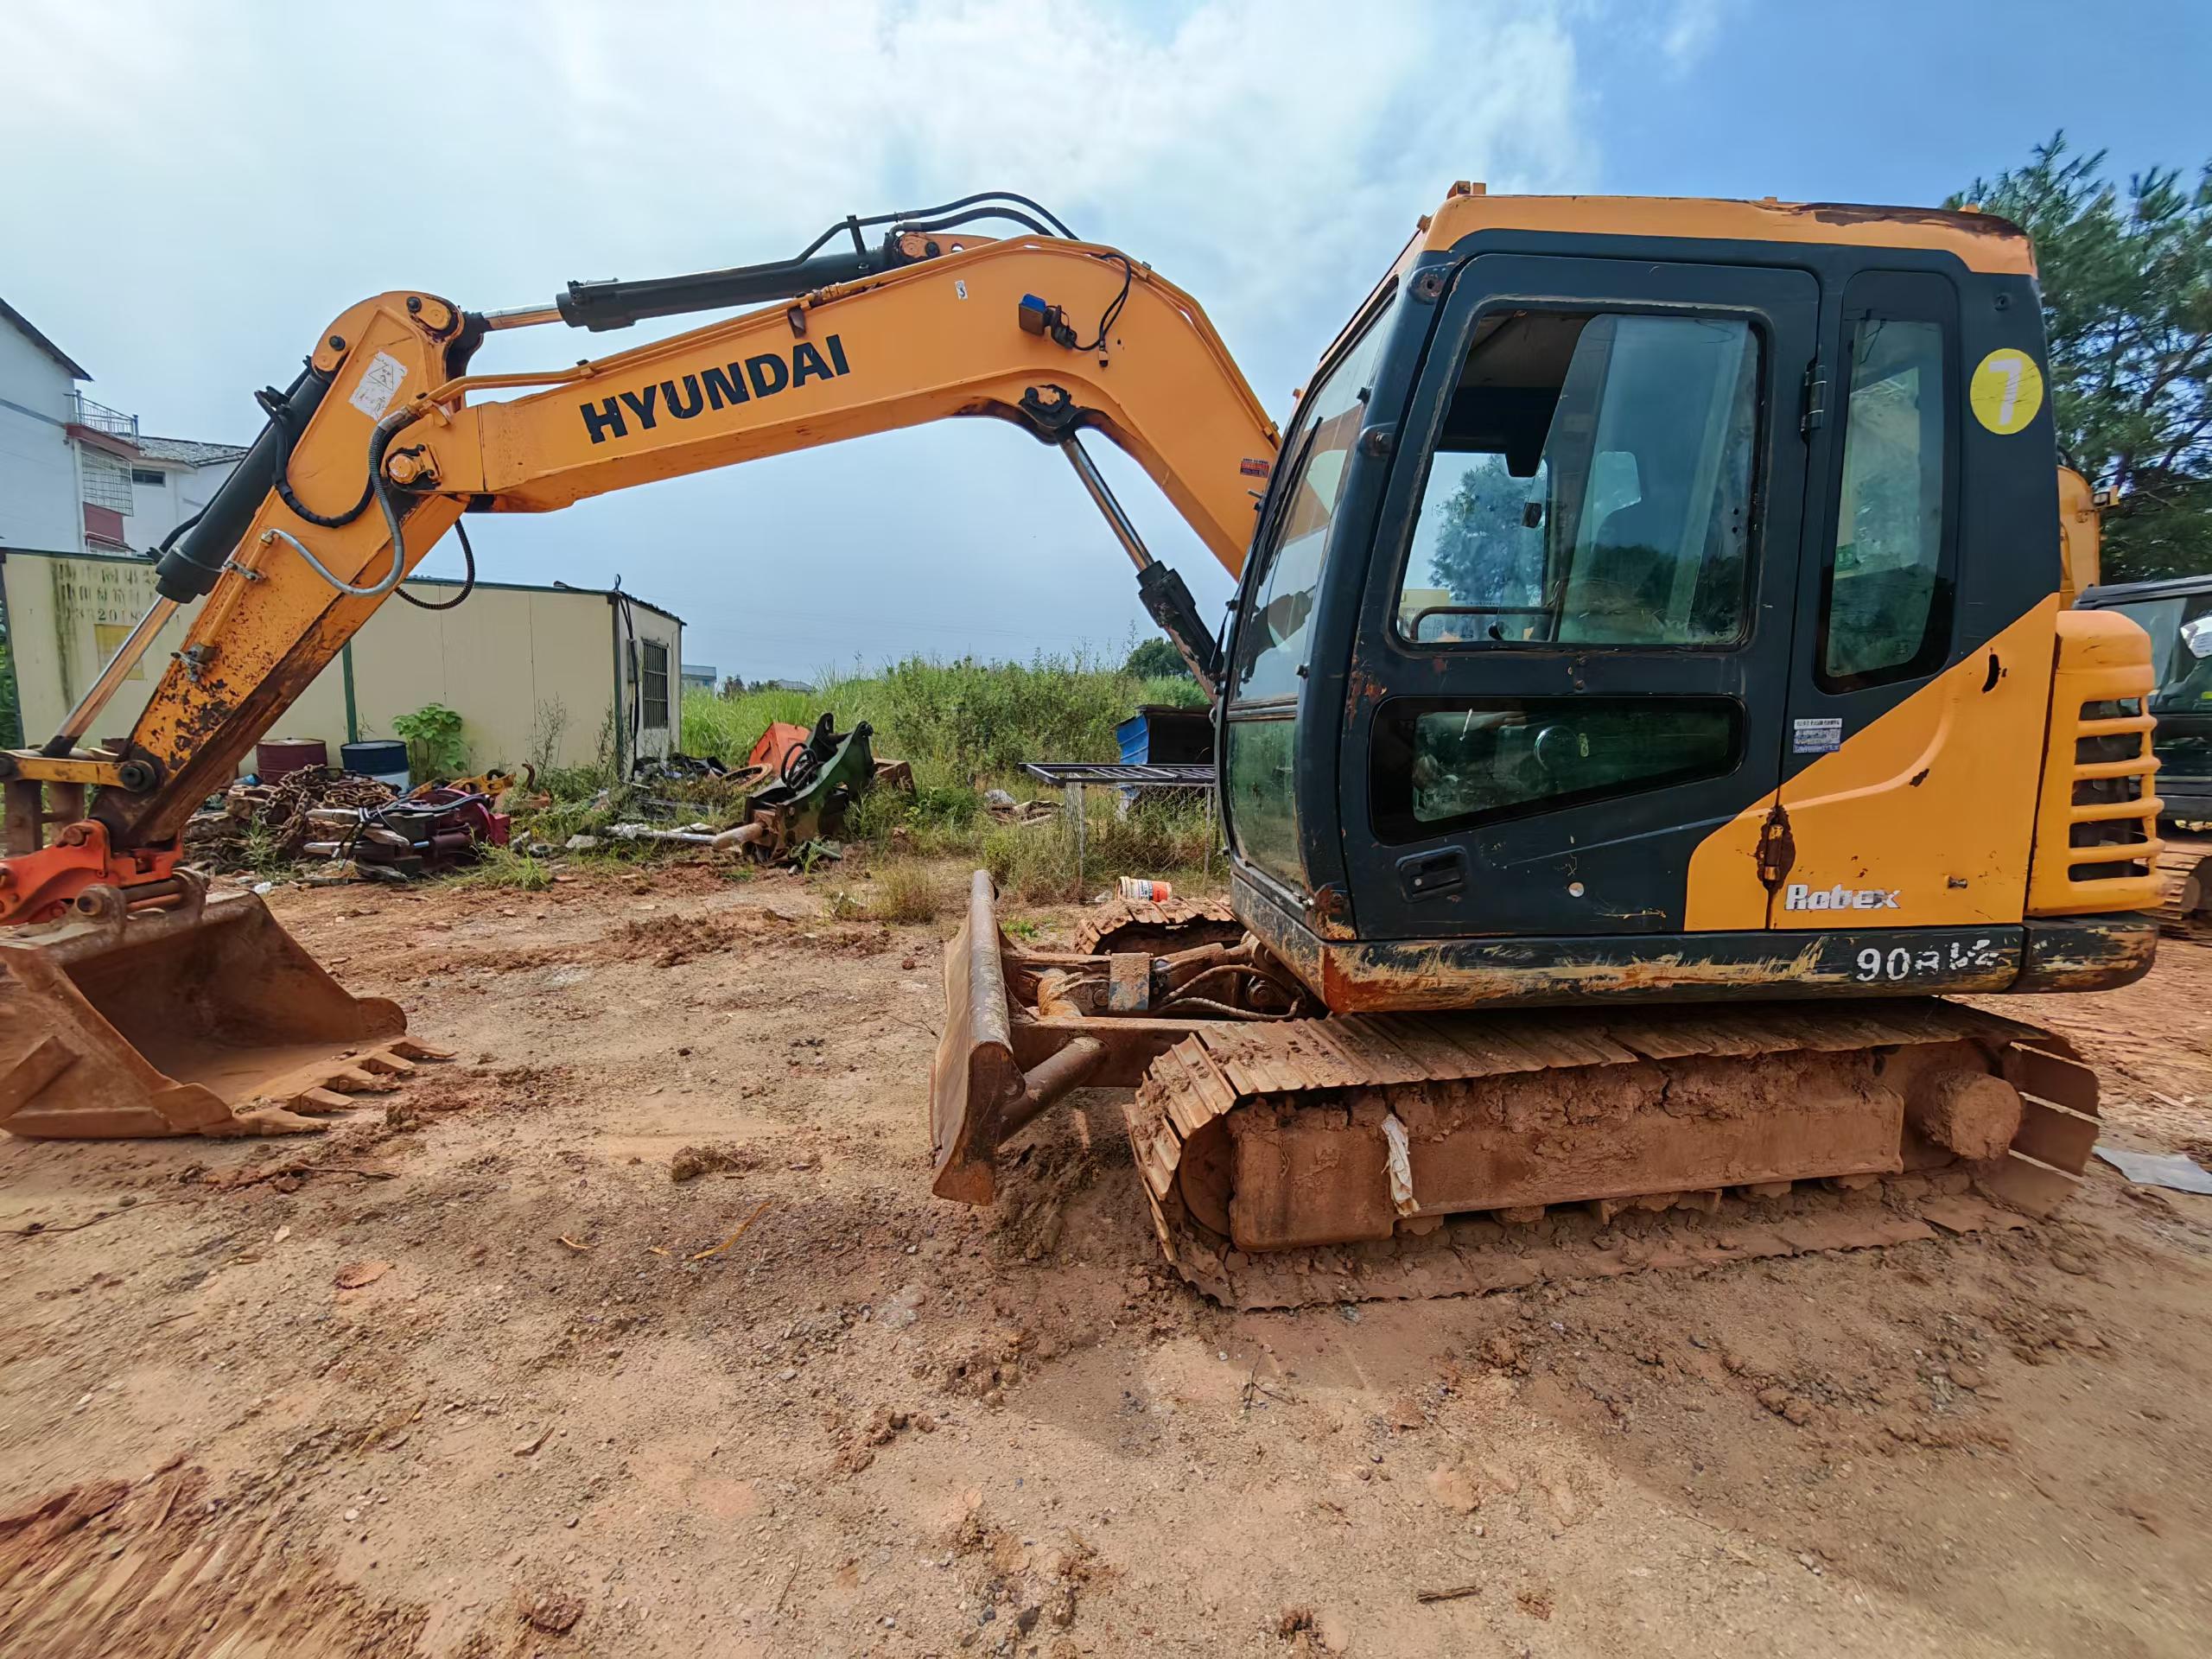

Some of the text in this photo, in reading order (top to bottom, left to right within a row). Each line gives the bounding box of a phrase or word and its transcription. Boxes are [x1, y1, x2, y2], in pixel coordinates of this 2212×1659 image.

[580, 334, 850, 444] HYUNDAI
[1988, 358, 2023, 426] 7
[1785, 884, 1901, 910] Robex
